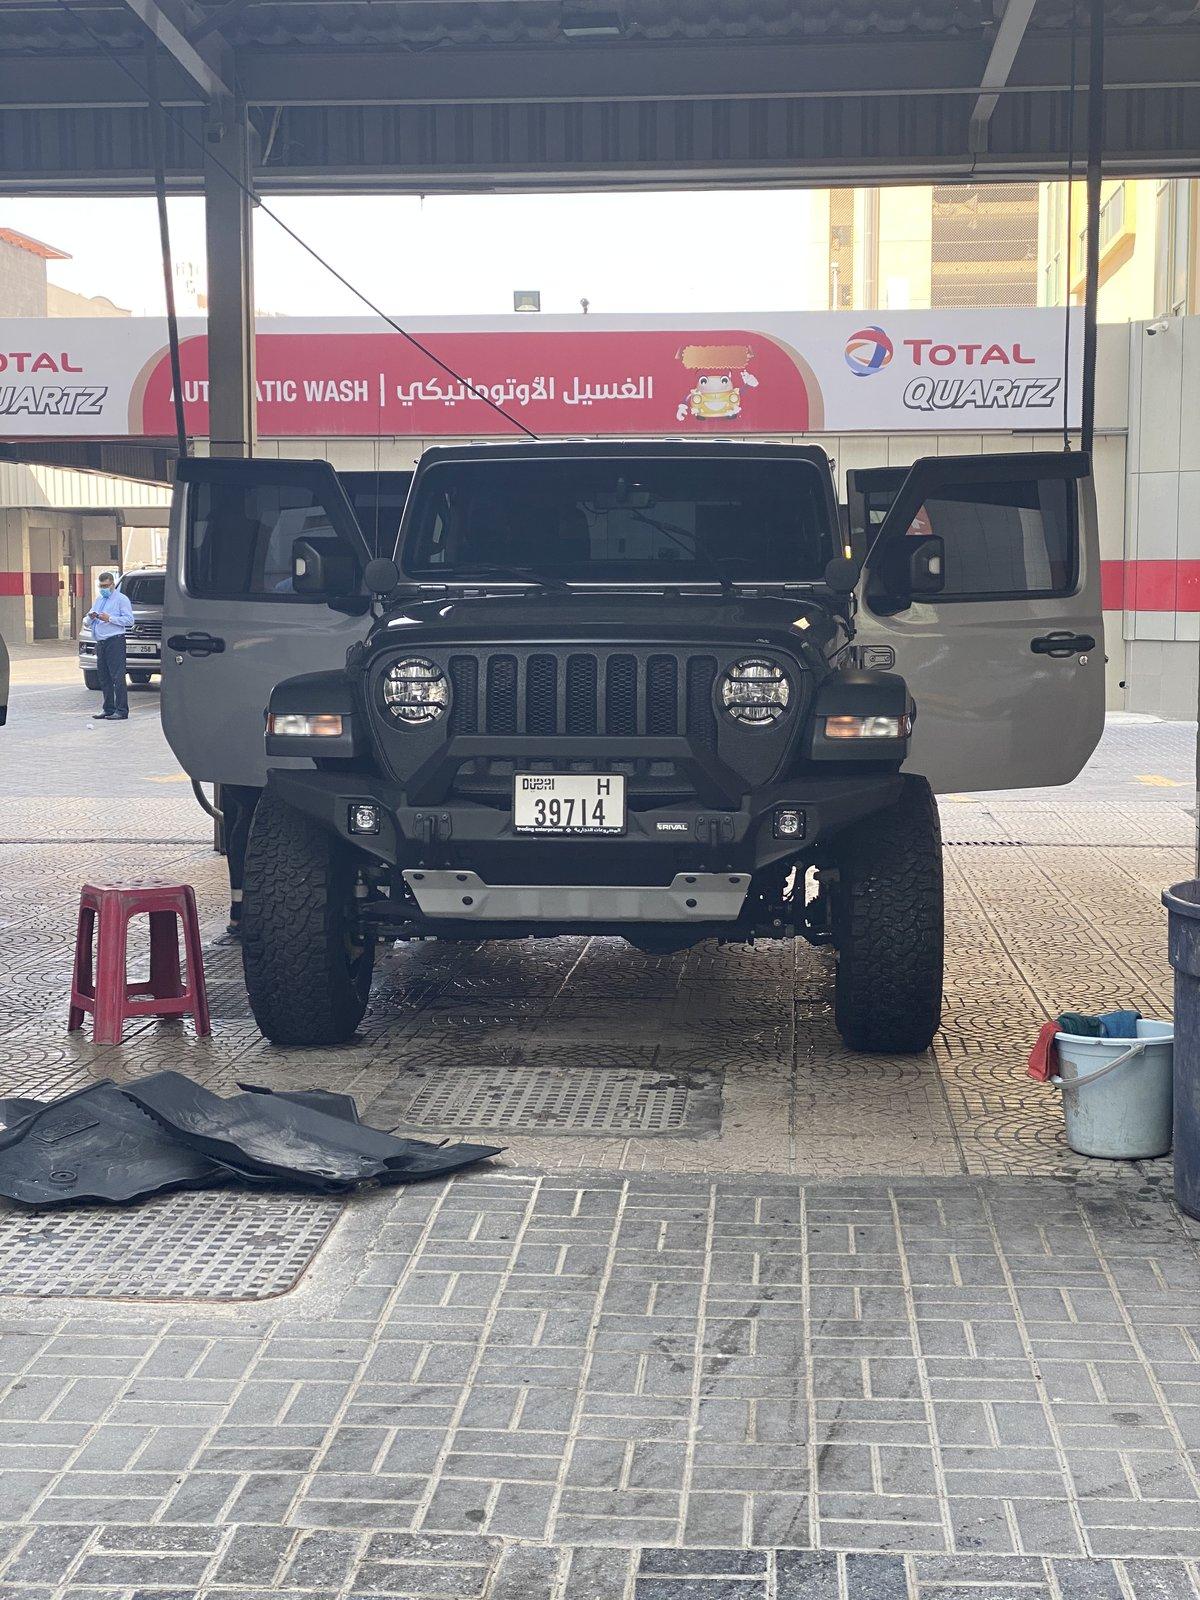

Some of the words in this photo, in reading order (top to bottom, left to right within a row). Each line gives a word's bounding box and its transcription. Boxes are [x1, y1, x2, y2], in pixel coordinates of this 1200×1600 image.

[903, 339, 1036, 366] TOTAL
[303, 380, 368, 402] WASH
[563, 376, 653, 405] الغسيل
[903, 376, 1062, 411] QUARTZ
[522, 778, 555, 790] DUBAI
[597, 778, 610, 796] H
[534, 798, 606, 827] 39714
[661, 823, 688, 831] RIVAL
